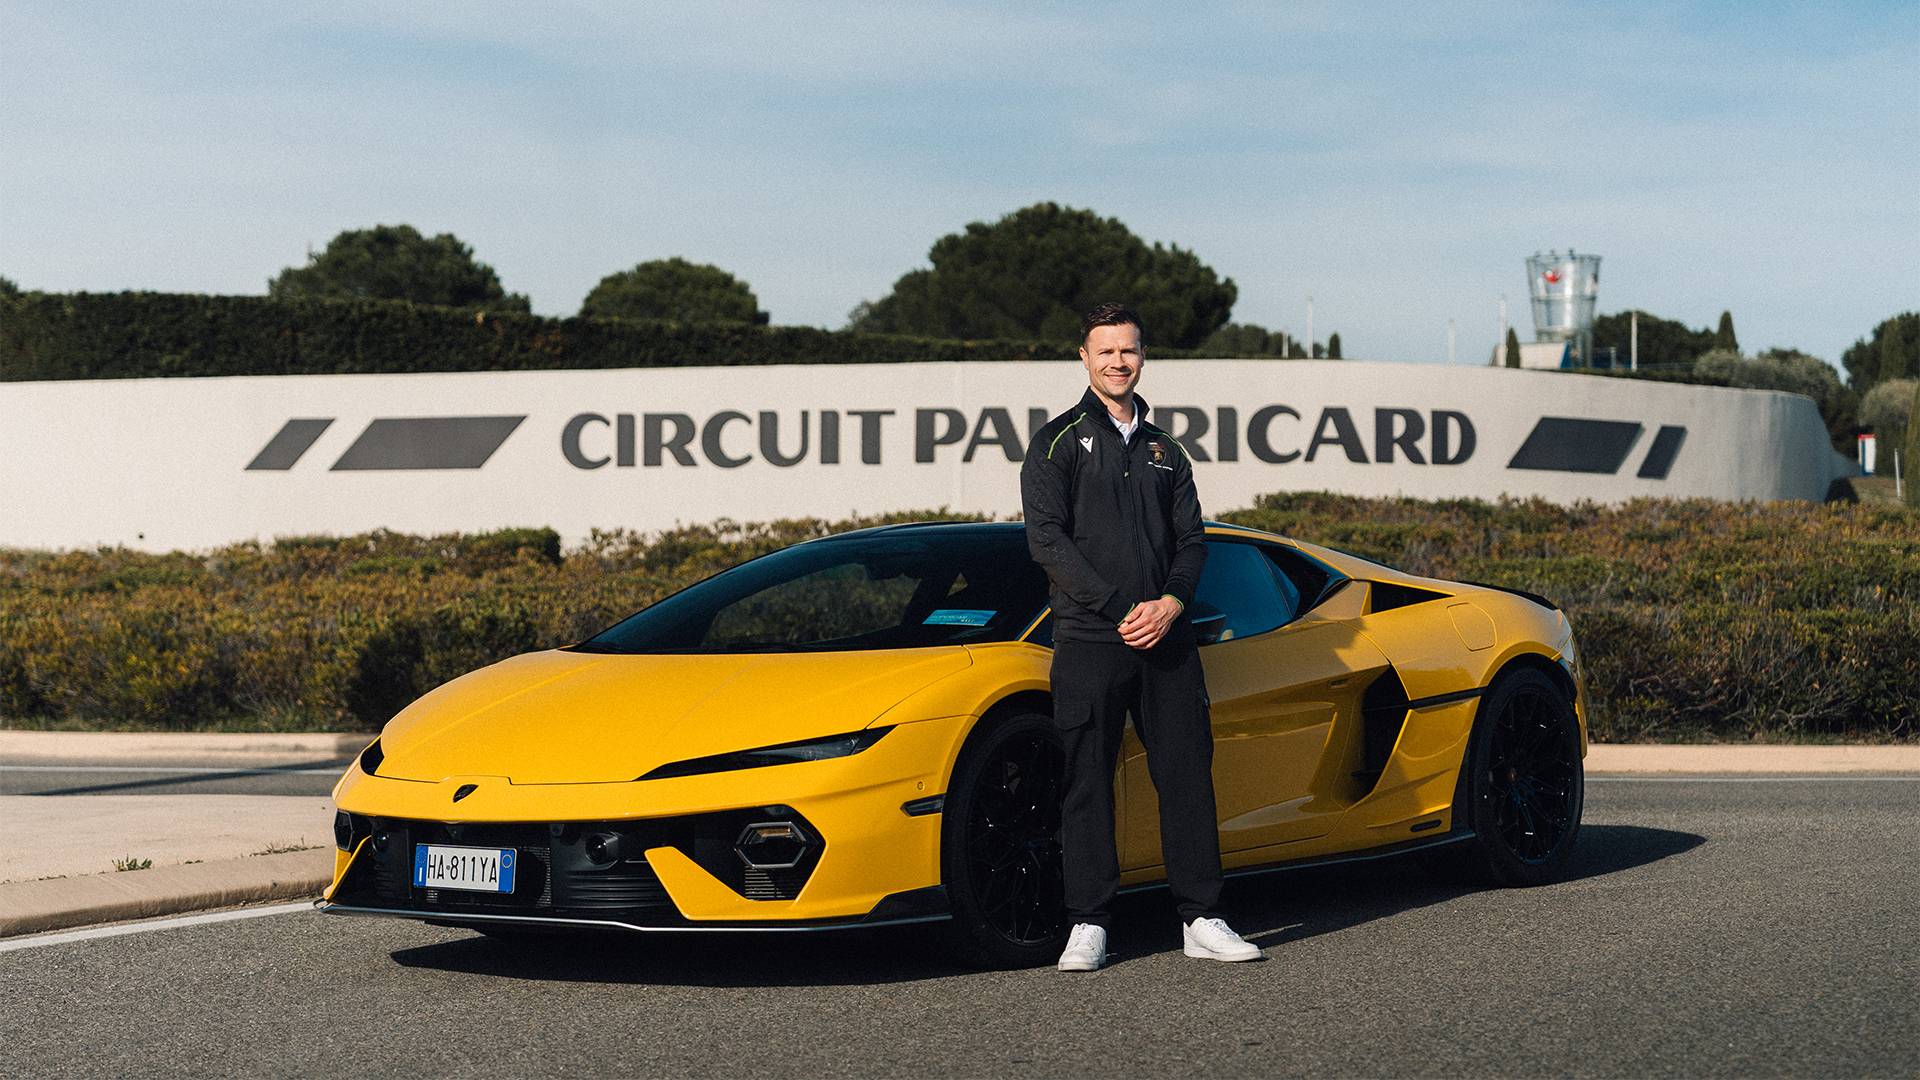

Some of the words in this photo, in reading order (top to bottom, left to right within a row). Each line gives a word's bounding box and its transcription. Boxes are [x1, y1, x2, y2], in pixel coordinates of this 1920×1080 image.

[561, 410, 896, 470] CIRCUIT
[914, 407, 1048, 463] PA
[1153, 405, 1477, 466] RICARD
